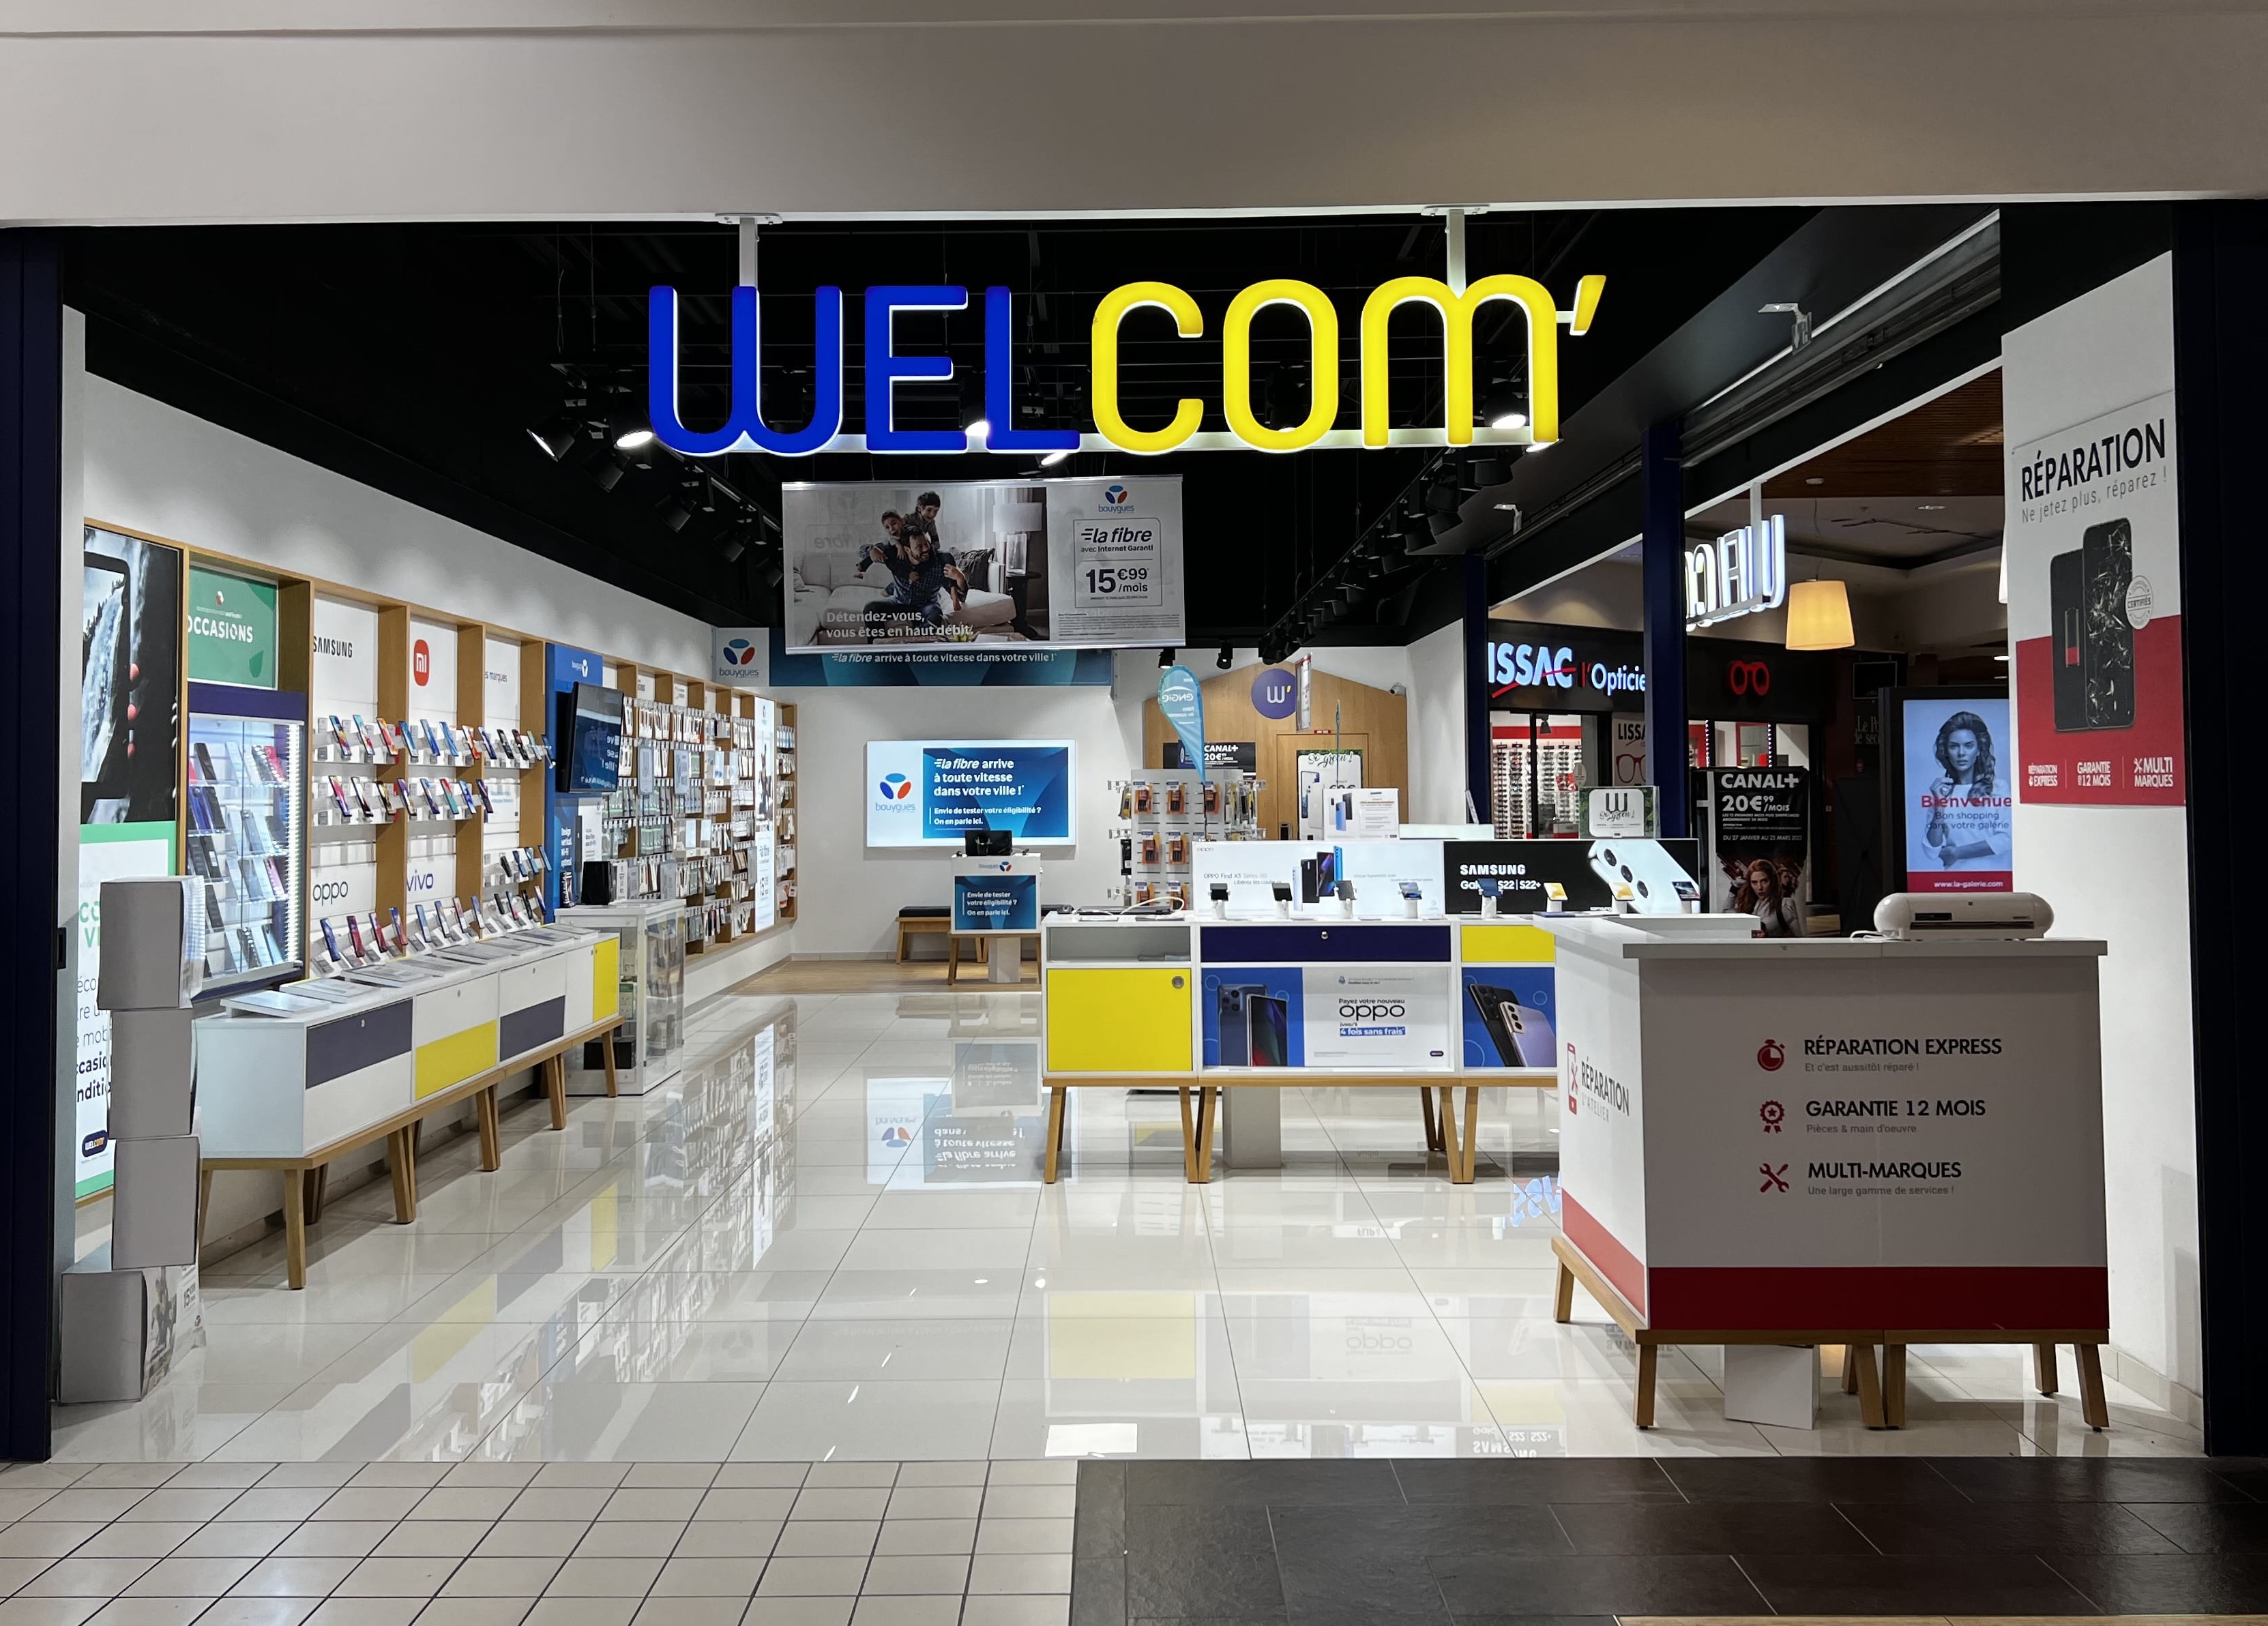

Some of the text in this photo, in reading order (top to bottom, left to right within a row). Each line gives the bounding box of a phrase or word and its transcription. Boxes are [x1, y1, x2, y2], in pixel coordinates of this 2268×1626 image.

[2022, 419, 2165, 502] RÉPARATION
[2022, 508, 2035, 523] Ne
[2039, 499, 2067, 522] jetez
[2072, 490, 2101, 514] plus,
[2106, 472, 2156, 499] réparez
[1098, 505, 1134, 514] bouygues
[1093, 527, 1152, 543] la fibre
[1086, 568, 1116, 593] 15
[1118, 583, 1148, 593] /mois
[827, 610, 925, 623] Détendez-vous,
[827, 628, 855, 638] vous
[858, 627, 885, 638] êtes
[887, 628, 902, 636] en
[906, 625, 933, 637] haut
[313, 636, 353, 657] SAMSUNG
[838, 653, 847, 662] la
[848, 653, 872, 663] fibre
[874, 653, 903, 662] arrive
[904, 653, 911, 662] à
[913, 654, 939, 662] toute
[941, 653, 975, 662] vitesse
[976, 653, 1000, 662] dans
[1029, 653, 1048, 662] ville
[719, 667, 759, 678] bouygues
[941, 758, 1014, 769] la fibre arrive
[1308, 753, 1320, 765] So
[2077, 760, 2111, 773] GARANTIE
[2143, 757, 2173, 774] MULTI
[934, 772, 1013, 783] à toute vitesse
[1721, 773, 1799, 788] CANAL+
[2082, 775, 2111, 786] 12 MOIS
[2134, 775, 2173, 788] MARQUES
[934, 785, 1016, 796] dans votre ville
[875, 802, 915, 813] bouygues
[1763, 803, 1790, 812] /MOIS
[1921, 795, 2012, 808] Bienvenue
[1003, 807, 1035, 815] éligibilité
[1956, 812, 1999, 821] shopping
[954, 818, 972, 826] parle
[1460, 864, 1526, 875] SAMSUNG
[407, 870, 434, 892] vivo
[1460, 881, 1542, 890] Gal S22 S22+
[1934, 881, 2003, 889] www.la-galerie.com
[312, 881, 349, 906] oppo
[1339, 1005, 1405, 1021] oppo
[1804, 1035, 2002, 1055] RÉPARATION EXPRESS
[1805, 1063, 1814, 1071] Et
[1817, 1063, 1839, 1071] c'est
[1842, 1063, 1881, 1071] aussitôt
[1883, 1063, 1914, 1073] réparé
[1582, 1055, 1629, 1117] RÉPARATION
[1806, 1099, 1986, 1117] GARANTIE 12 MOIS
[1806, 1124, 1917, 1133] Pièces & main d'oeuvre
[1808, 1162, 1962, 1179] MULTI-MARQUES
[1808, 1186, 1827, 1195] Une
[1829, 1186, 1853, 1196] large
[1855, 1187, 1891, 1196] gamme
[1894, 1186, 1906, 1194] de
[1909, 1186, 1948, 1194] services
